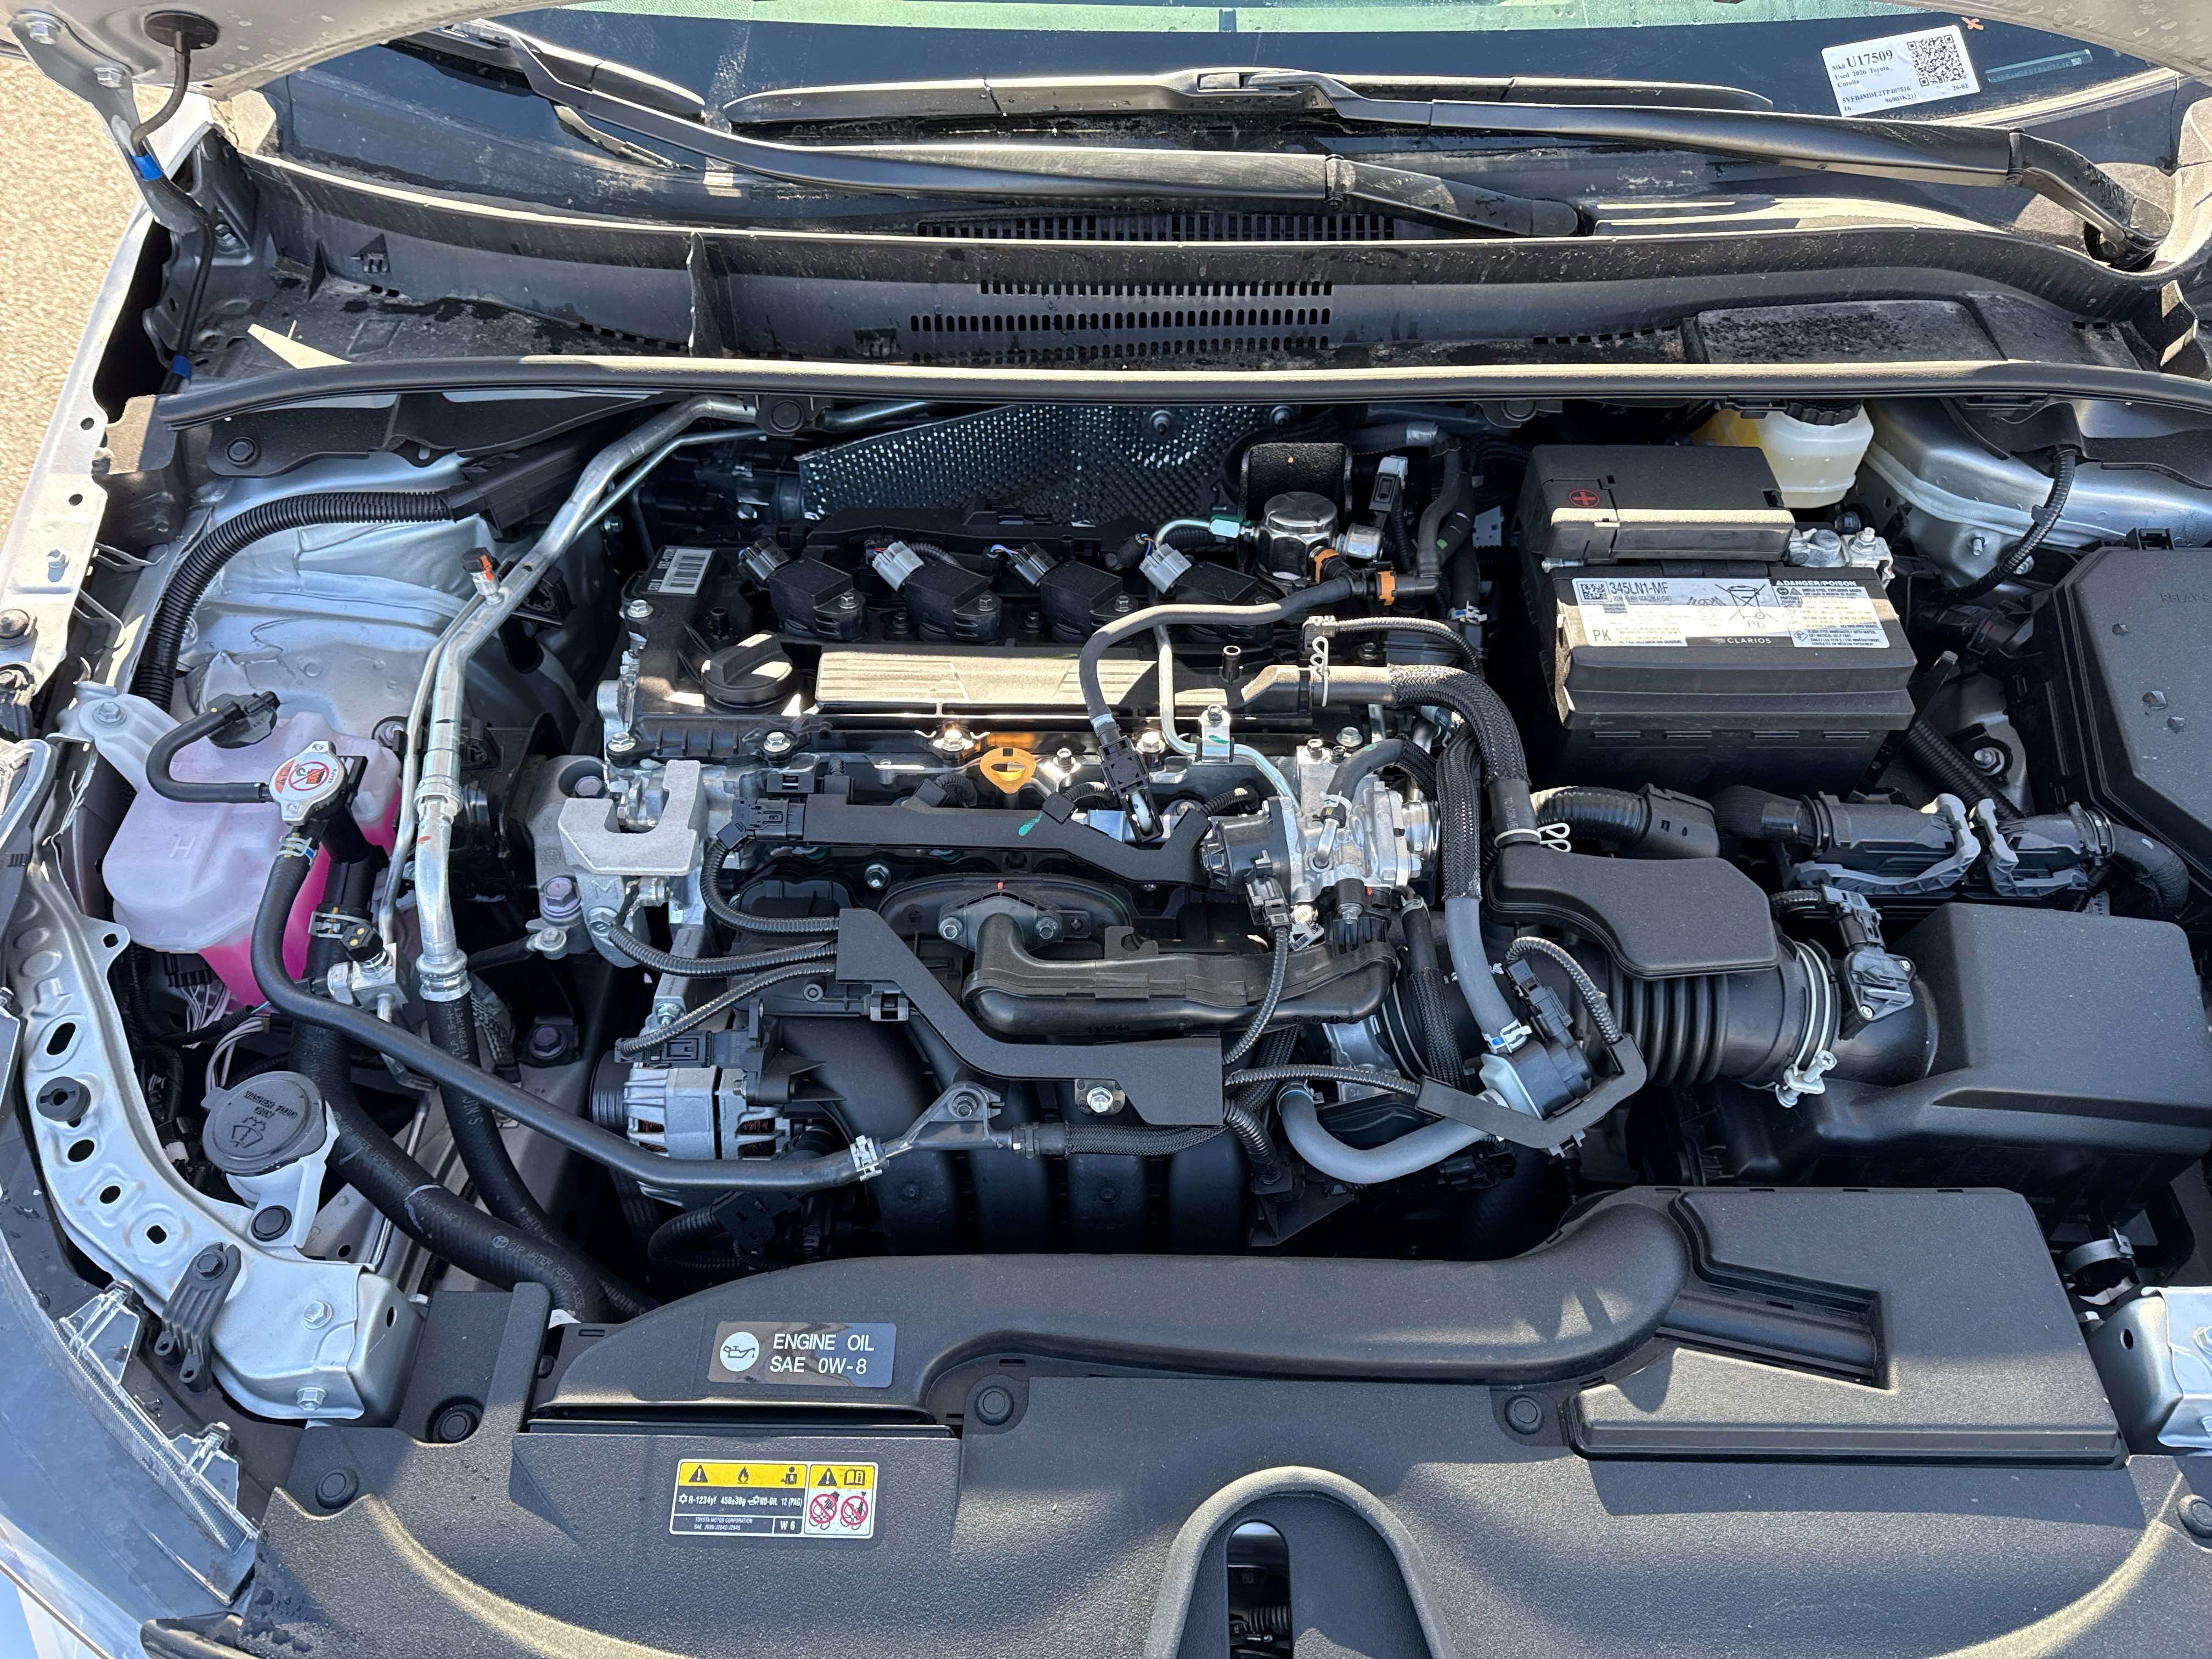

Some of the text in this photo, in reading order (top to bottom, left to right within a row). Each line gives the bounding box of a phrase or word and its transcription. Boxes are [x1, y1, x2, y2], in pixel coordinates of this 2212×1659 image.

[1846, 50, 1893, 68] U17509
[1835, 72, 1850, 81] Used
[1837, 78, 1860, 88] Corolla
[1610, 582, 1668, 594] 345LN1-MF
[2160, 592, 2198, 603] RELAY
[1592, 629, 1611, 642] PK
[594, 879, 619, 899] M
[243, 1090, 298, 1120] WASHER FLUID
[253, 1106, 276, 1119] ONLY
[526, 1250, 554, 1266] WATER
[773, 1333, 874, 1351] ENGINE OIL
[770, 1356, 867, 1375] SAE 0W-8
[688, 1496, 803, 1508] R-1234yf 450±30g ND-OIL 12 (PAG)
[780, 1520, 795, 1531] W 6
